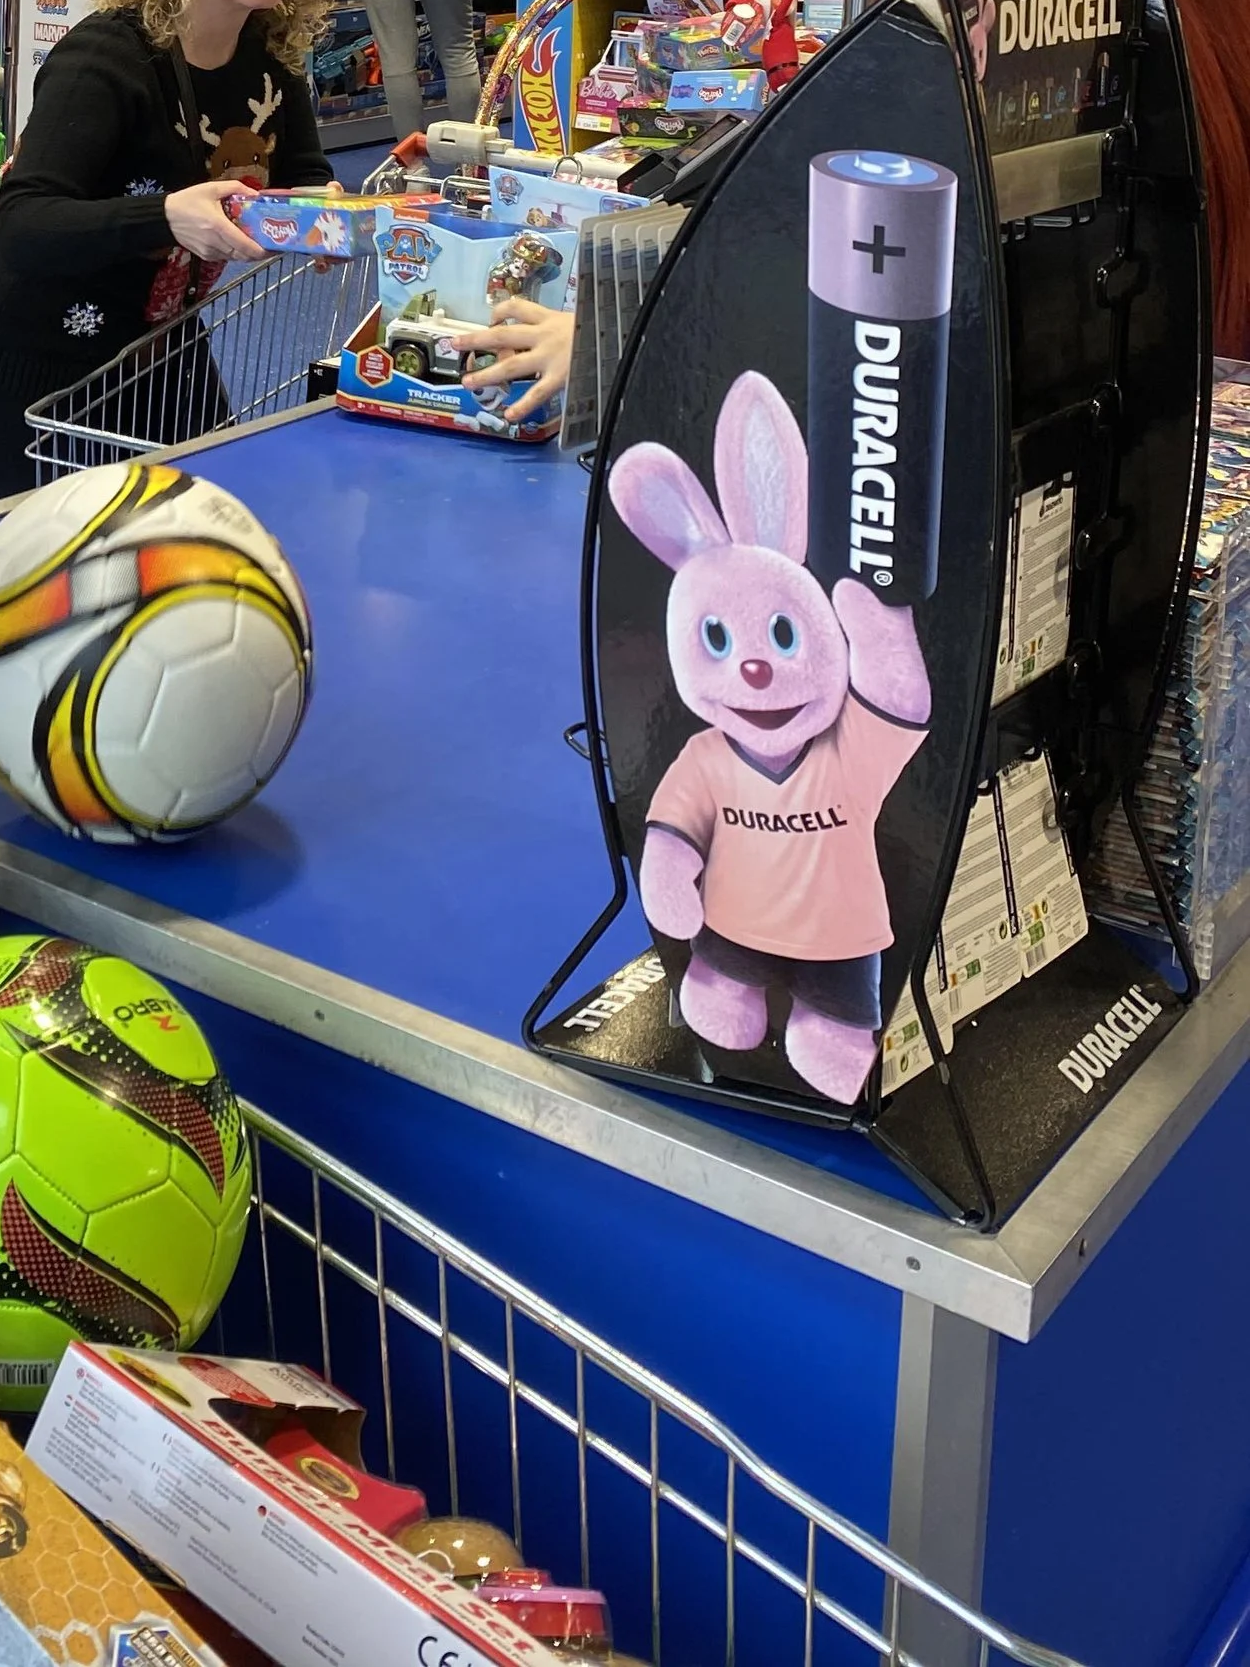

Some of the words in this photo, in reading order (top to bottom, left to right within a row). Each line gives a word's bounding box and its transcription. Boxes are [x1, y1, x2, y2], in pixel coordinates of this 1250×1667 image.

[580, 77, 616, 99] Barbie
[375, 230, 442, 265] PAW
[388, 262, 423, 275] PATROL
[407, 389, 460, 405] TRACKER
[853, 321, 900, 575] DURACELL
[722, 807, 848, 833] DURACELL
[1057, 984, 1163, 1094] DURACELL
[201, 1420, 343, 1515] Burger
[347, 1524, 456, 1594] Meal
[457, 1600, 537, 1655] Set
